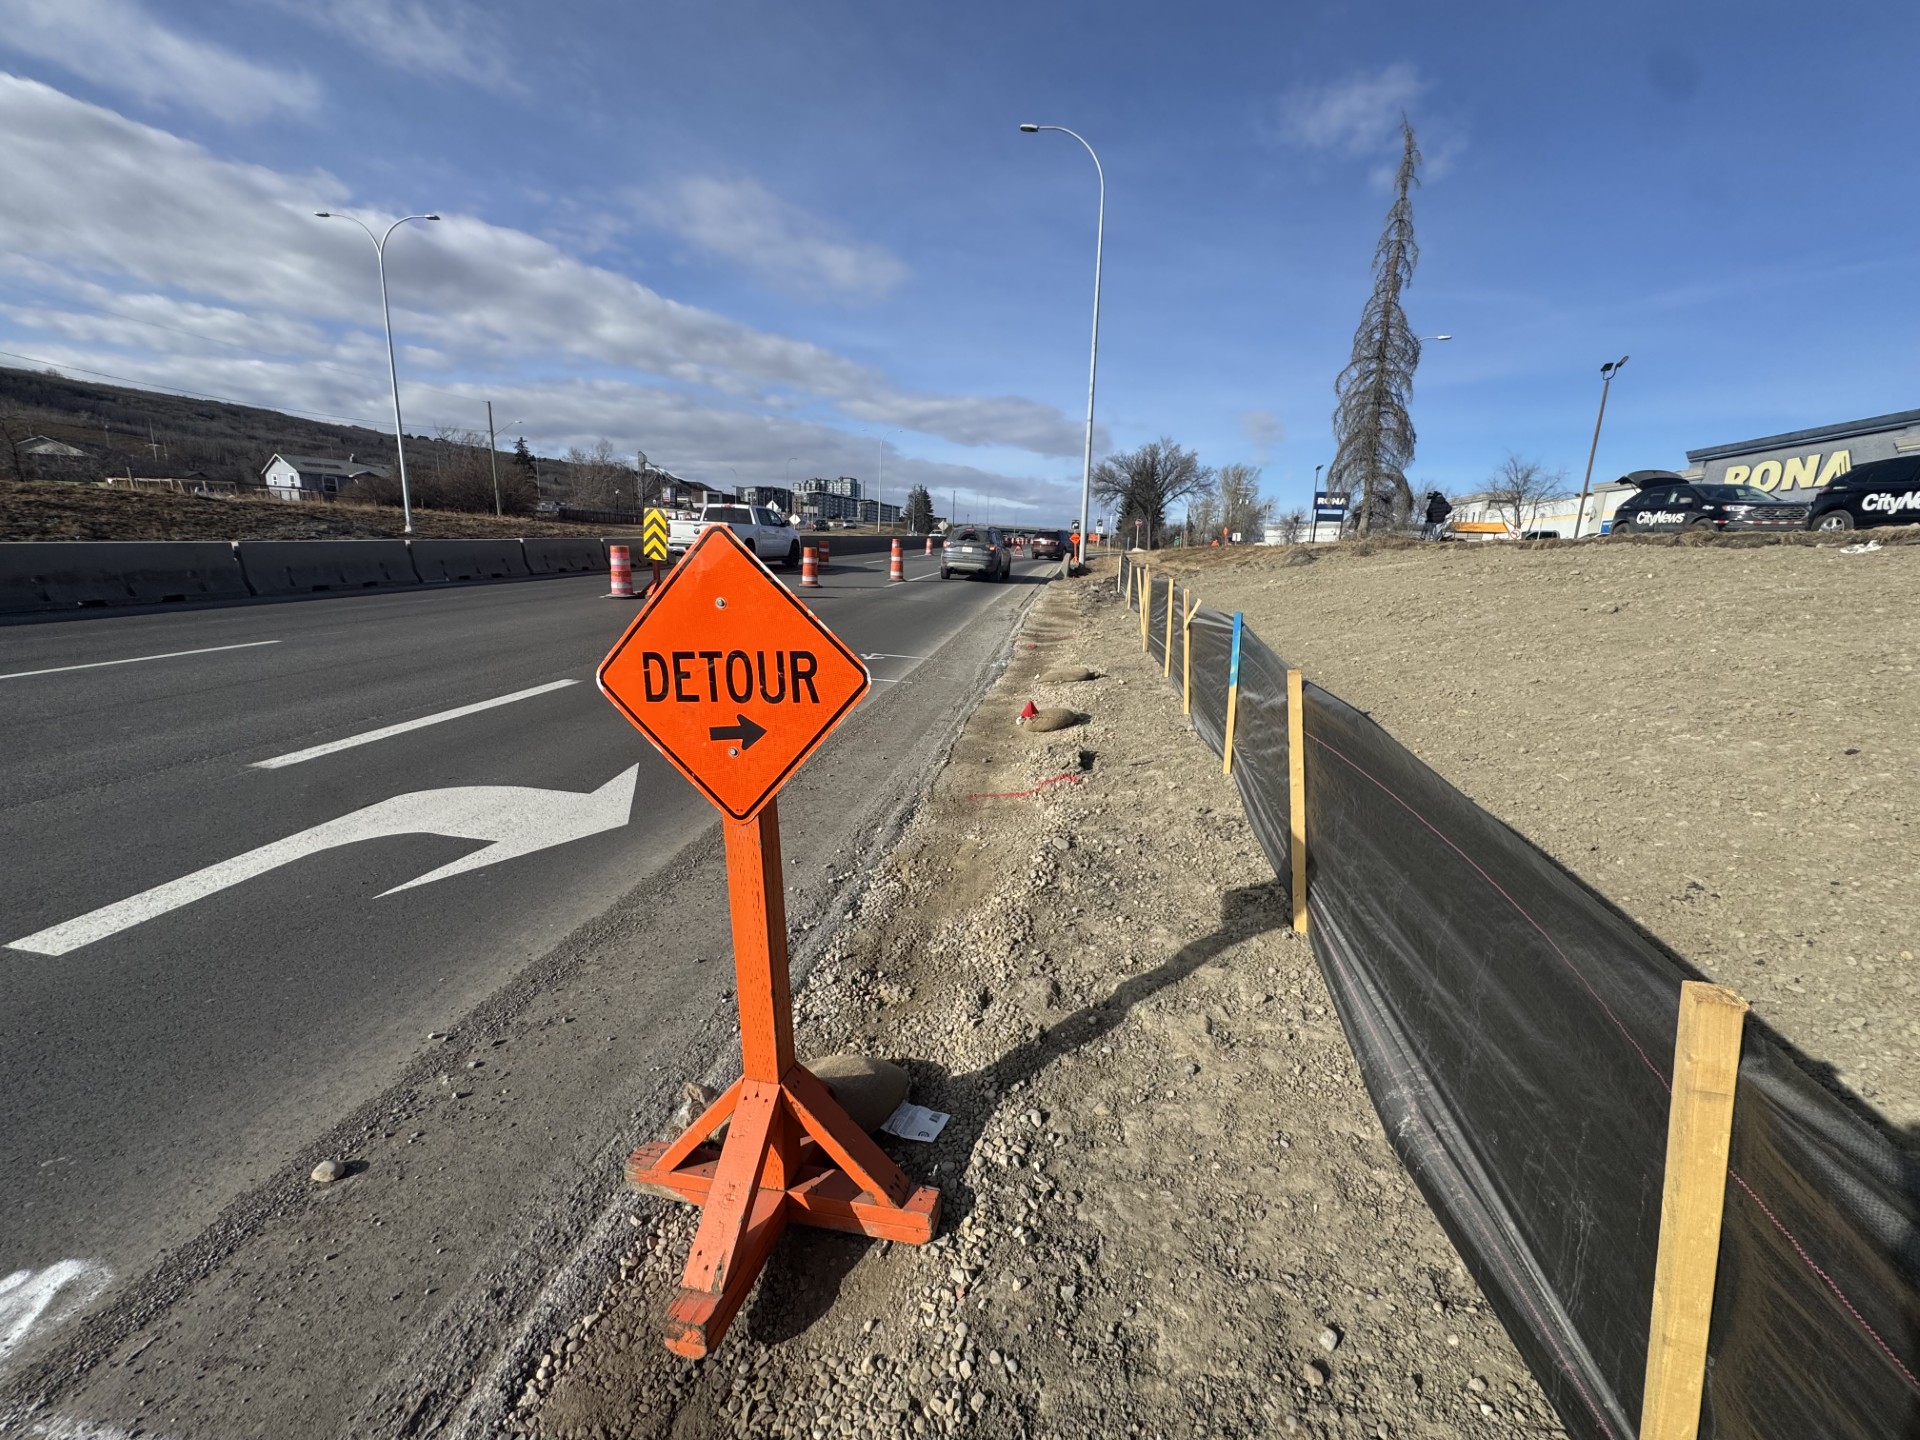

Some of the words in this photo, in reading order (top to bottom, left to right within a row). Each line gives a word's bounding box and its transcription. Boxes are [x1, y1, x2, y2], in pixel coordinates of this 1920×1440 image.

[1724, 450, 1851, 492] RONA
[1317, 497, 1347, 505] RONA
[1636, 510, 1685, 526] CityNews
[642, 650, 820, 704] DETOUR
